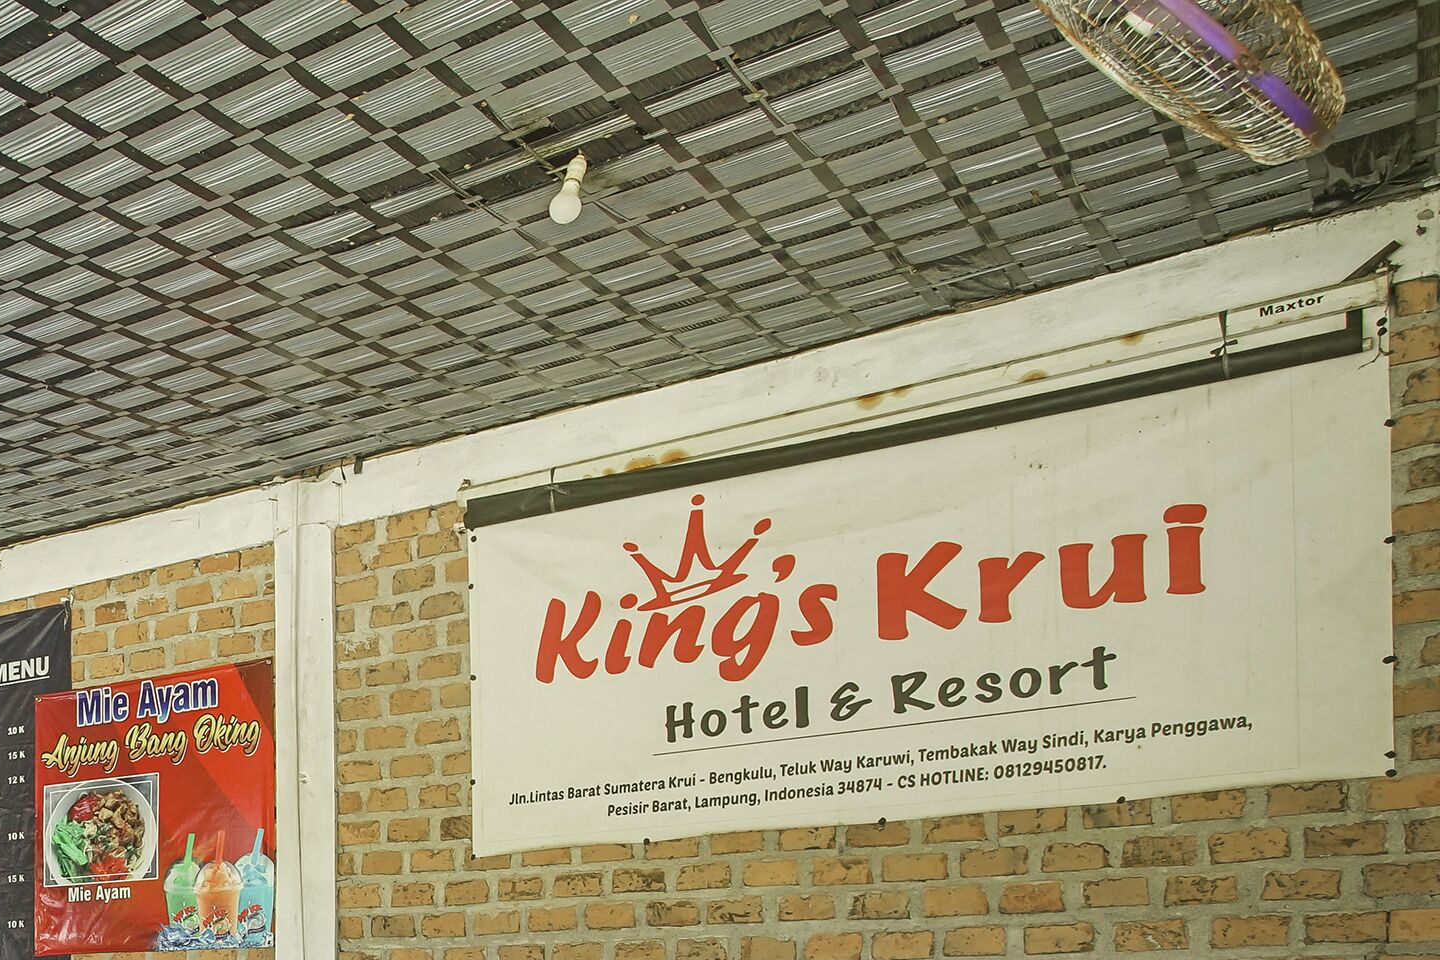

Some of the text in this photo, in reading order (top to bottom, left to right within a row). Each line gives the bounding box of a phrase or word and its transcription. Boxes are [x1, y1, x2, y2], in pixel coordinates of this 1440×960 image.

[1260, 295, 1324, 317] Maxtor
[535, 504, 1207, 685] King's Krui
[76, 678, 218, 727] Mie Ayam
[663, 646, 1117, 742] Hotel & Resort
[8, 727, 16, 735] 10
[125, 723, 187, 765] Bang
[192, 714, 262, 755] Oking
[568, 784, 601, 799] Barat
[604, 779, 665, 795] Sumatera
[669, 773, 696, 789] Krui
[709, 766, 776, 784] Bengkulu,
[780, 761, 816, 777] Teluk
[820, 758, 852, 773] Way
[856, 750, 915, 769] Karuwi,
[918, 741, 997, 762] Tembakak
[1002, 738, 1037, 754] Way
[1043, 731, 1089, 749] Sindi,
[1094, 726, 1146, 744] Karya
[1151, 715, 1252, 737] Penggawa,
[608, 803, 649, 816] Pesisir
[652, 798, 691, 812] Barat,
[695, 791, 761, 809] Lampung,
[765, 783, 833, 802] Indonesia
[838, 777, 882, 795] 34874
[898, 775, 915, 789] CS
[920, 769, 989, 787] HOTLINE:
[994, 755, 1107, 779] 08129450817.
[68, 885, 131, 902] Mie Ayam
[19, 920, 25, 928] K
